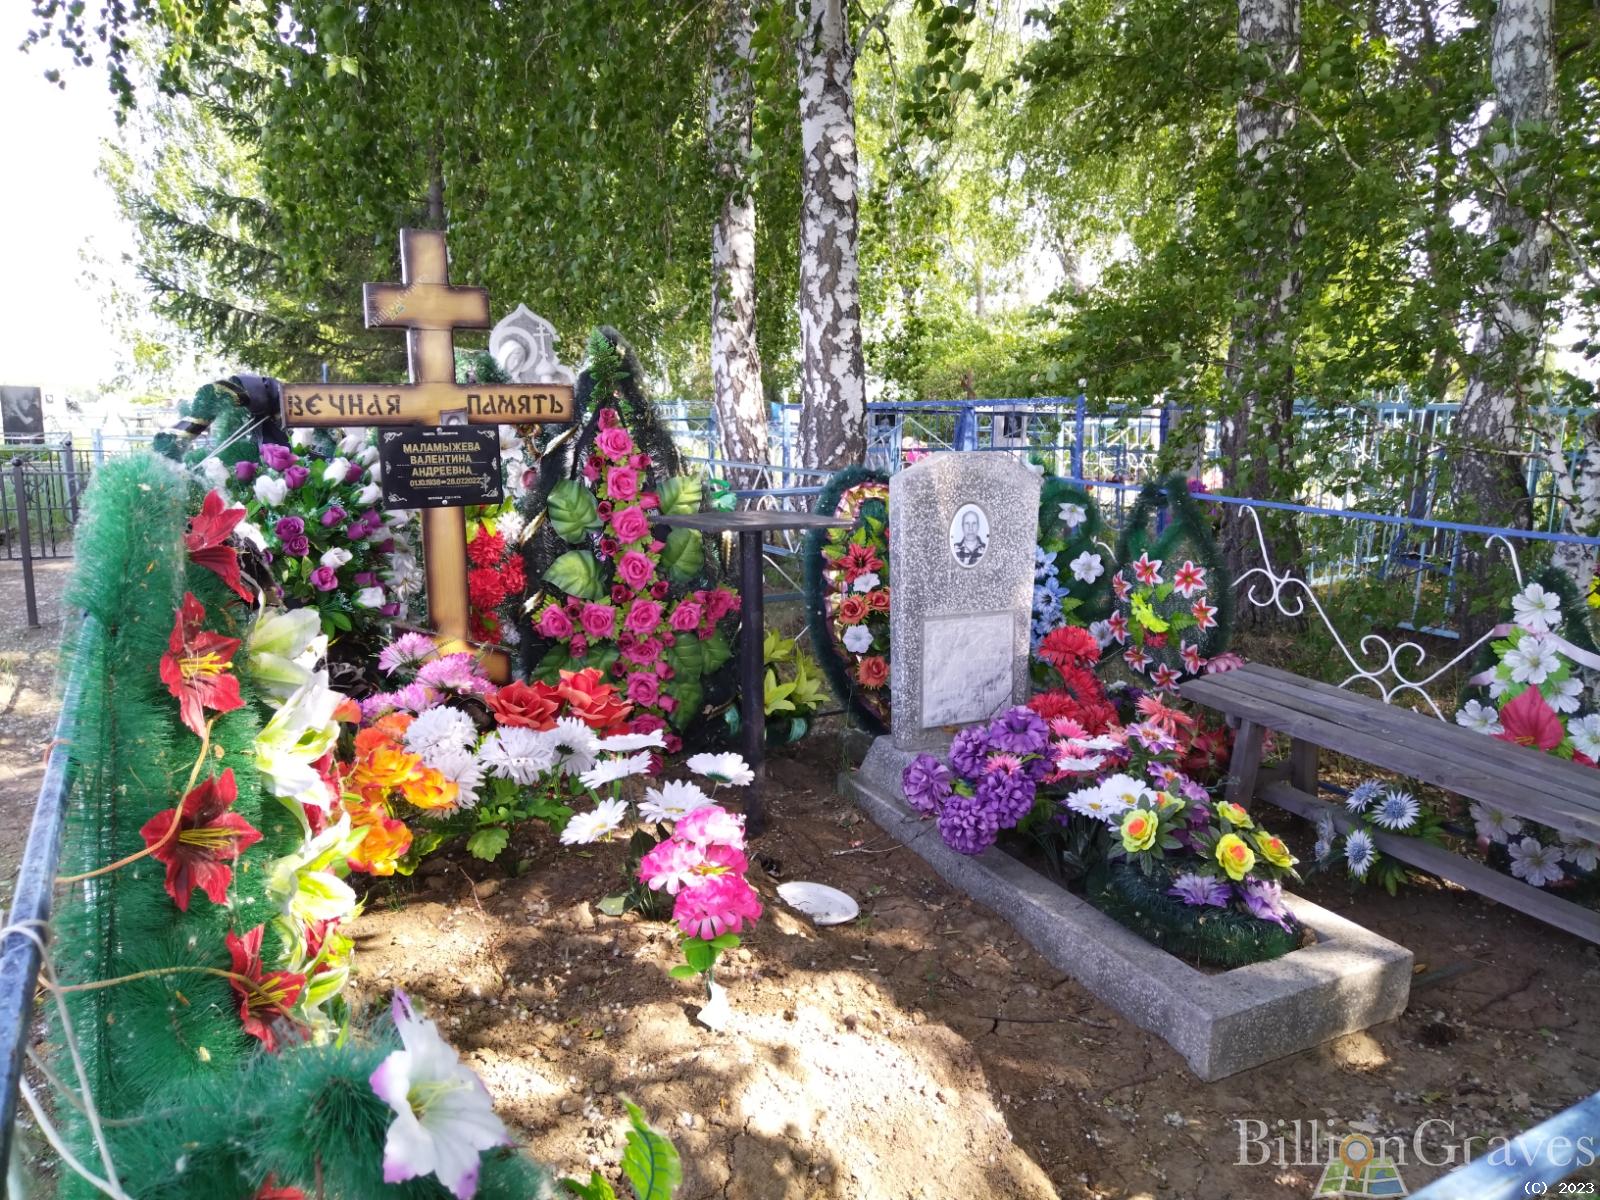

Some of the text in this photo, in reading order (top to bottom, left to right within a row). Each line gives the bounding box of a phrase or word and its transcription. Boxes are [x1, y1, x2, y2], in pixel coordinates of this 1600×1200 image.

[467, 393, 564, 415] ПАМЯТЬ
[402, 442, 481, 454] МАЛАМЫЖЕВА
[410, 454, 472, 465] ВАЛЕНТИНА
[412, 466, 472, 478] АНДРЕЕВНА
